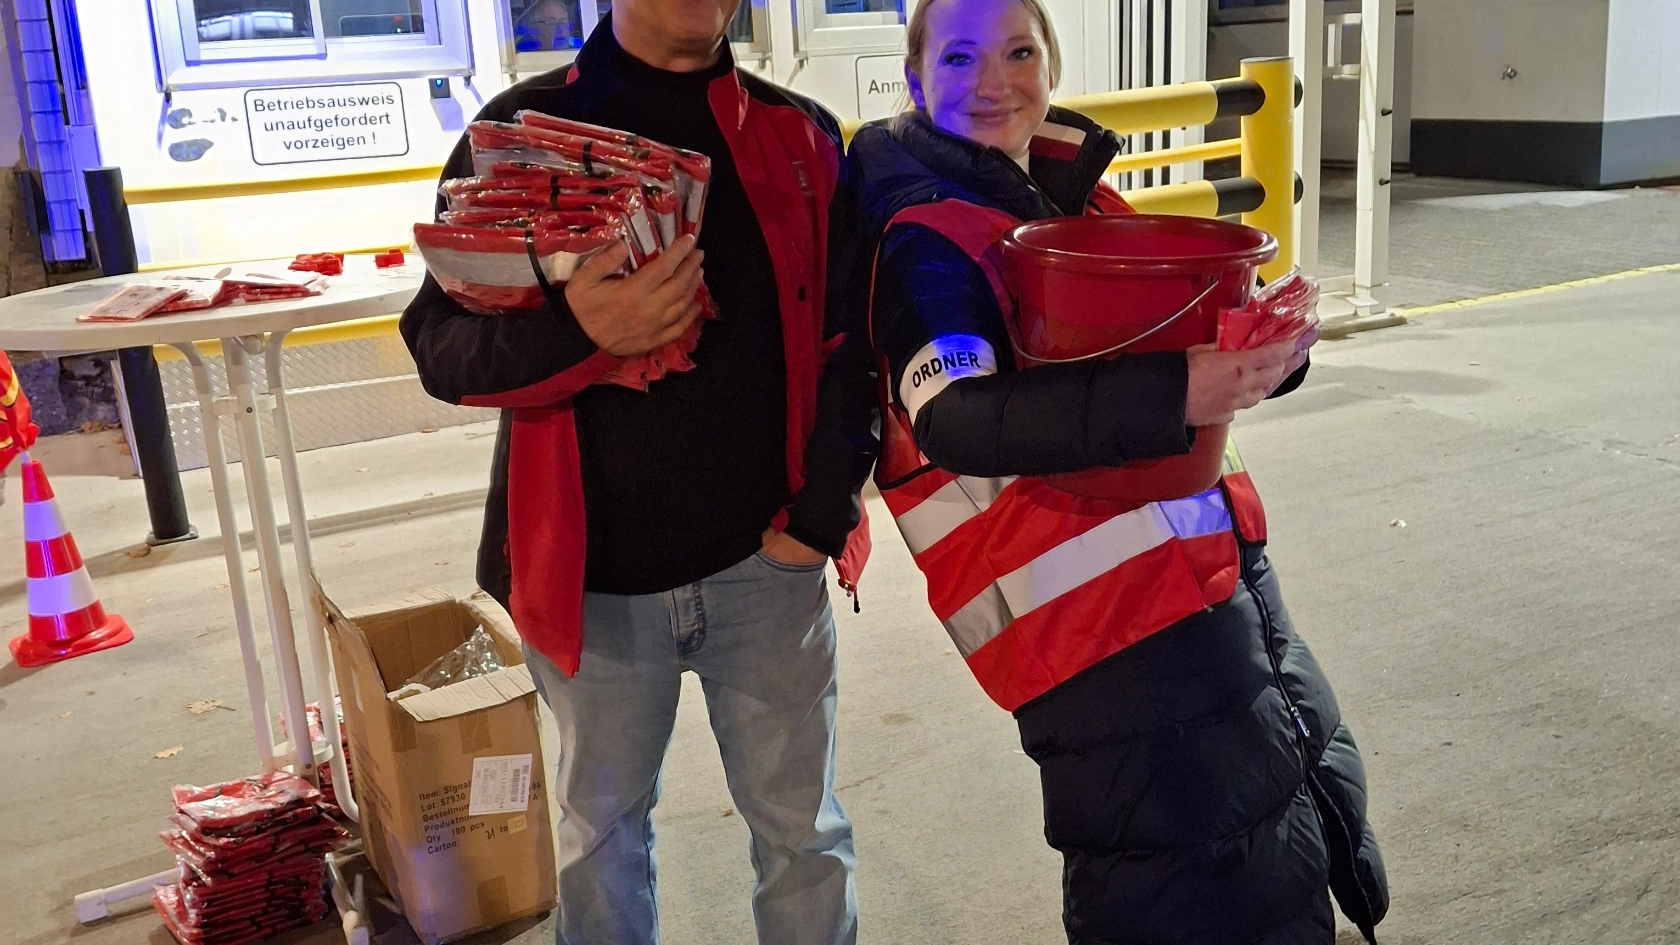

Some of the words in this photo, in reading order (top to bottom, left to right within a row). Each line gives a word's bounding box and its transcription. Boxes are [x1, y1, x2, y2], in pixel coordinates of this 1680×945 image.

[253, 92, 395, 112] Betriebsausweis
[264, 112, 391, 132] unaufgefordert
[283, 134, 366, 151] vorzeigen
[372, 132, 377, 145] !
[912, 351, 981, 388] ORDNER
[440, 792, 466, 806] 57930
[451, 825, 466, 836] 100
[470, 821, 485, 832] pcs
